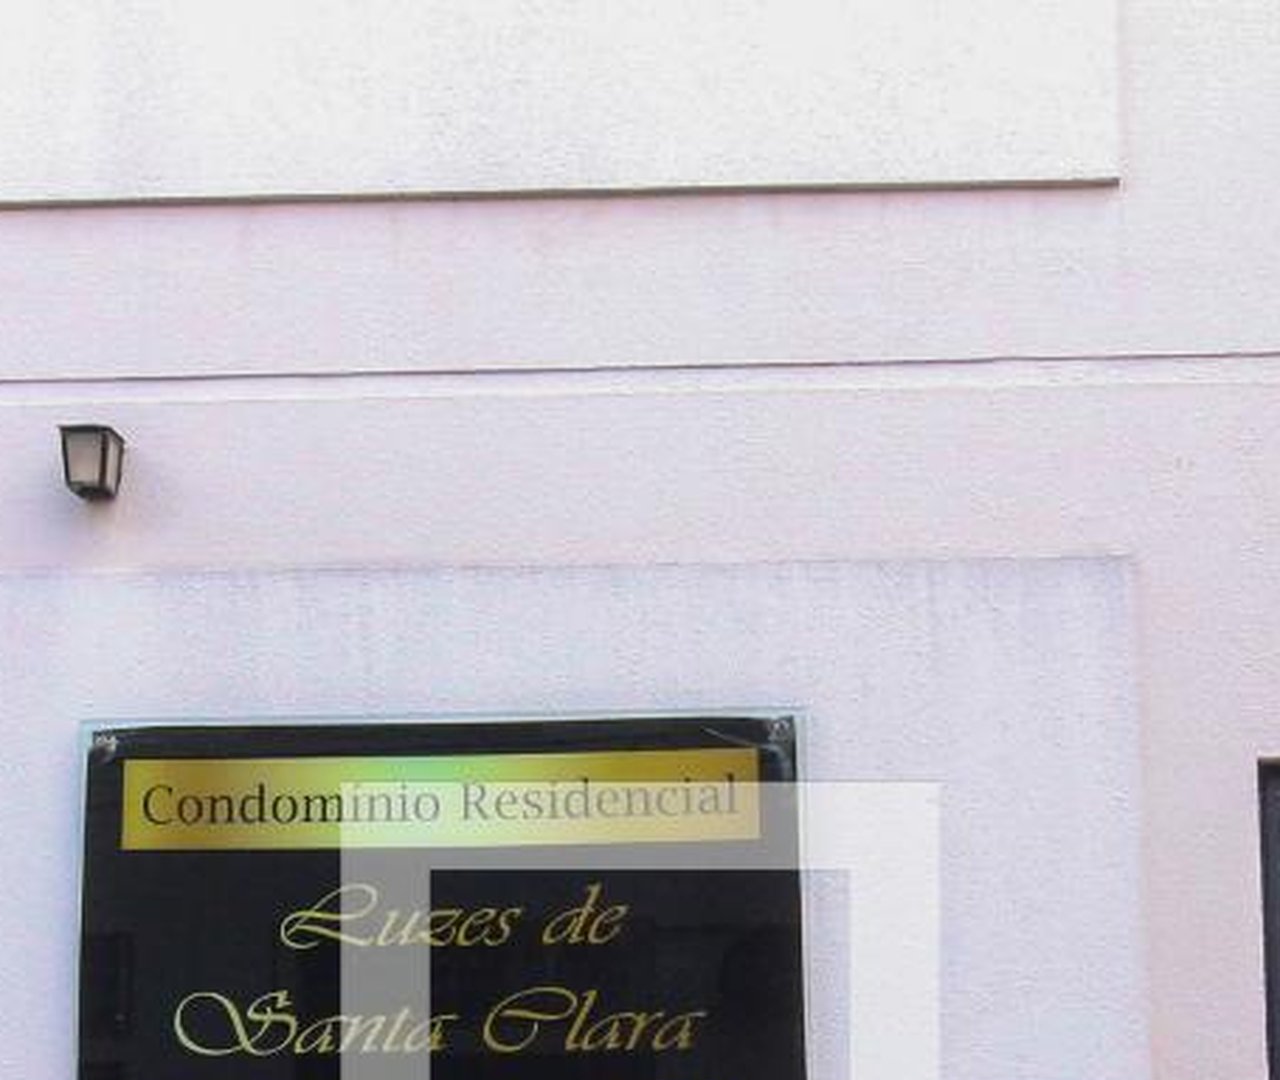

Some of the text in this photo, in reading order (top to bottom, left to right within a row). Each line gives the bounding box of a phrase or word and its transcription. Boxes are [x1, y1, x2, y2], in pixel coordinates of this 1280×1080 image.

[462, 773, 740, 821] Residencial
[280, 880, 628, 949] Luzes de
[173, 986, 708, 1057] Santa Clara
